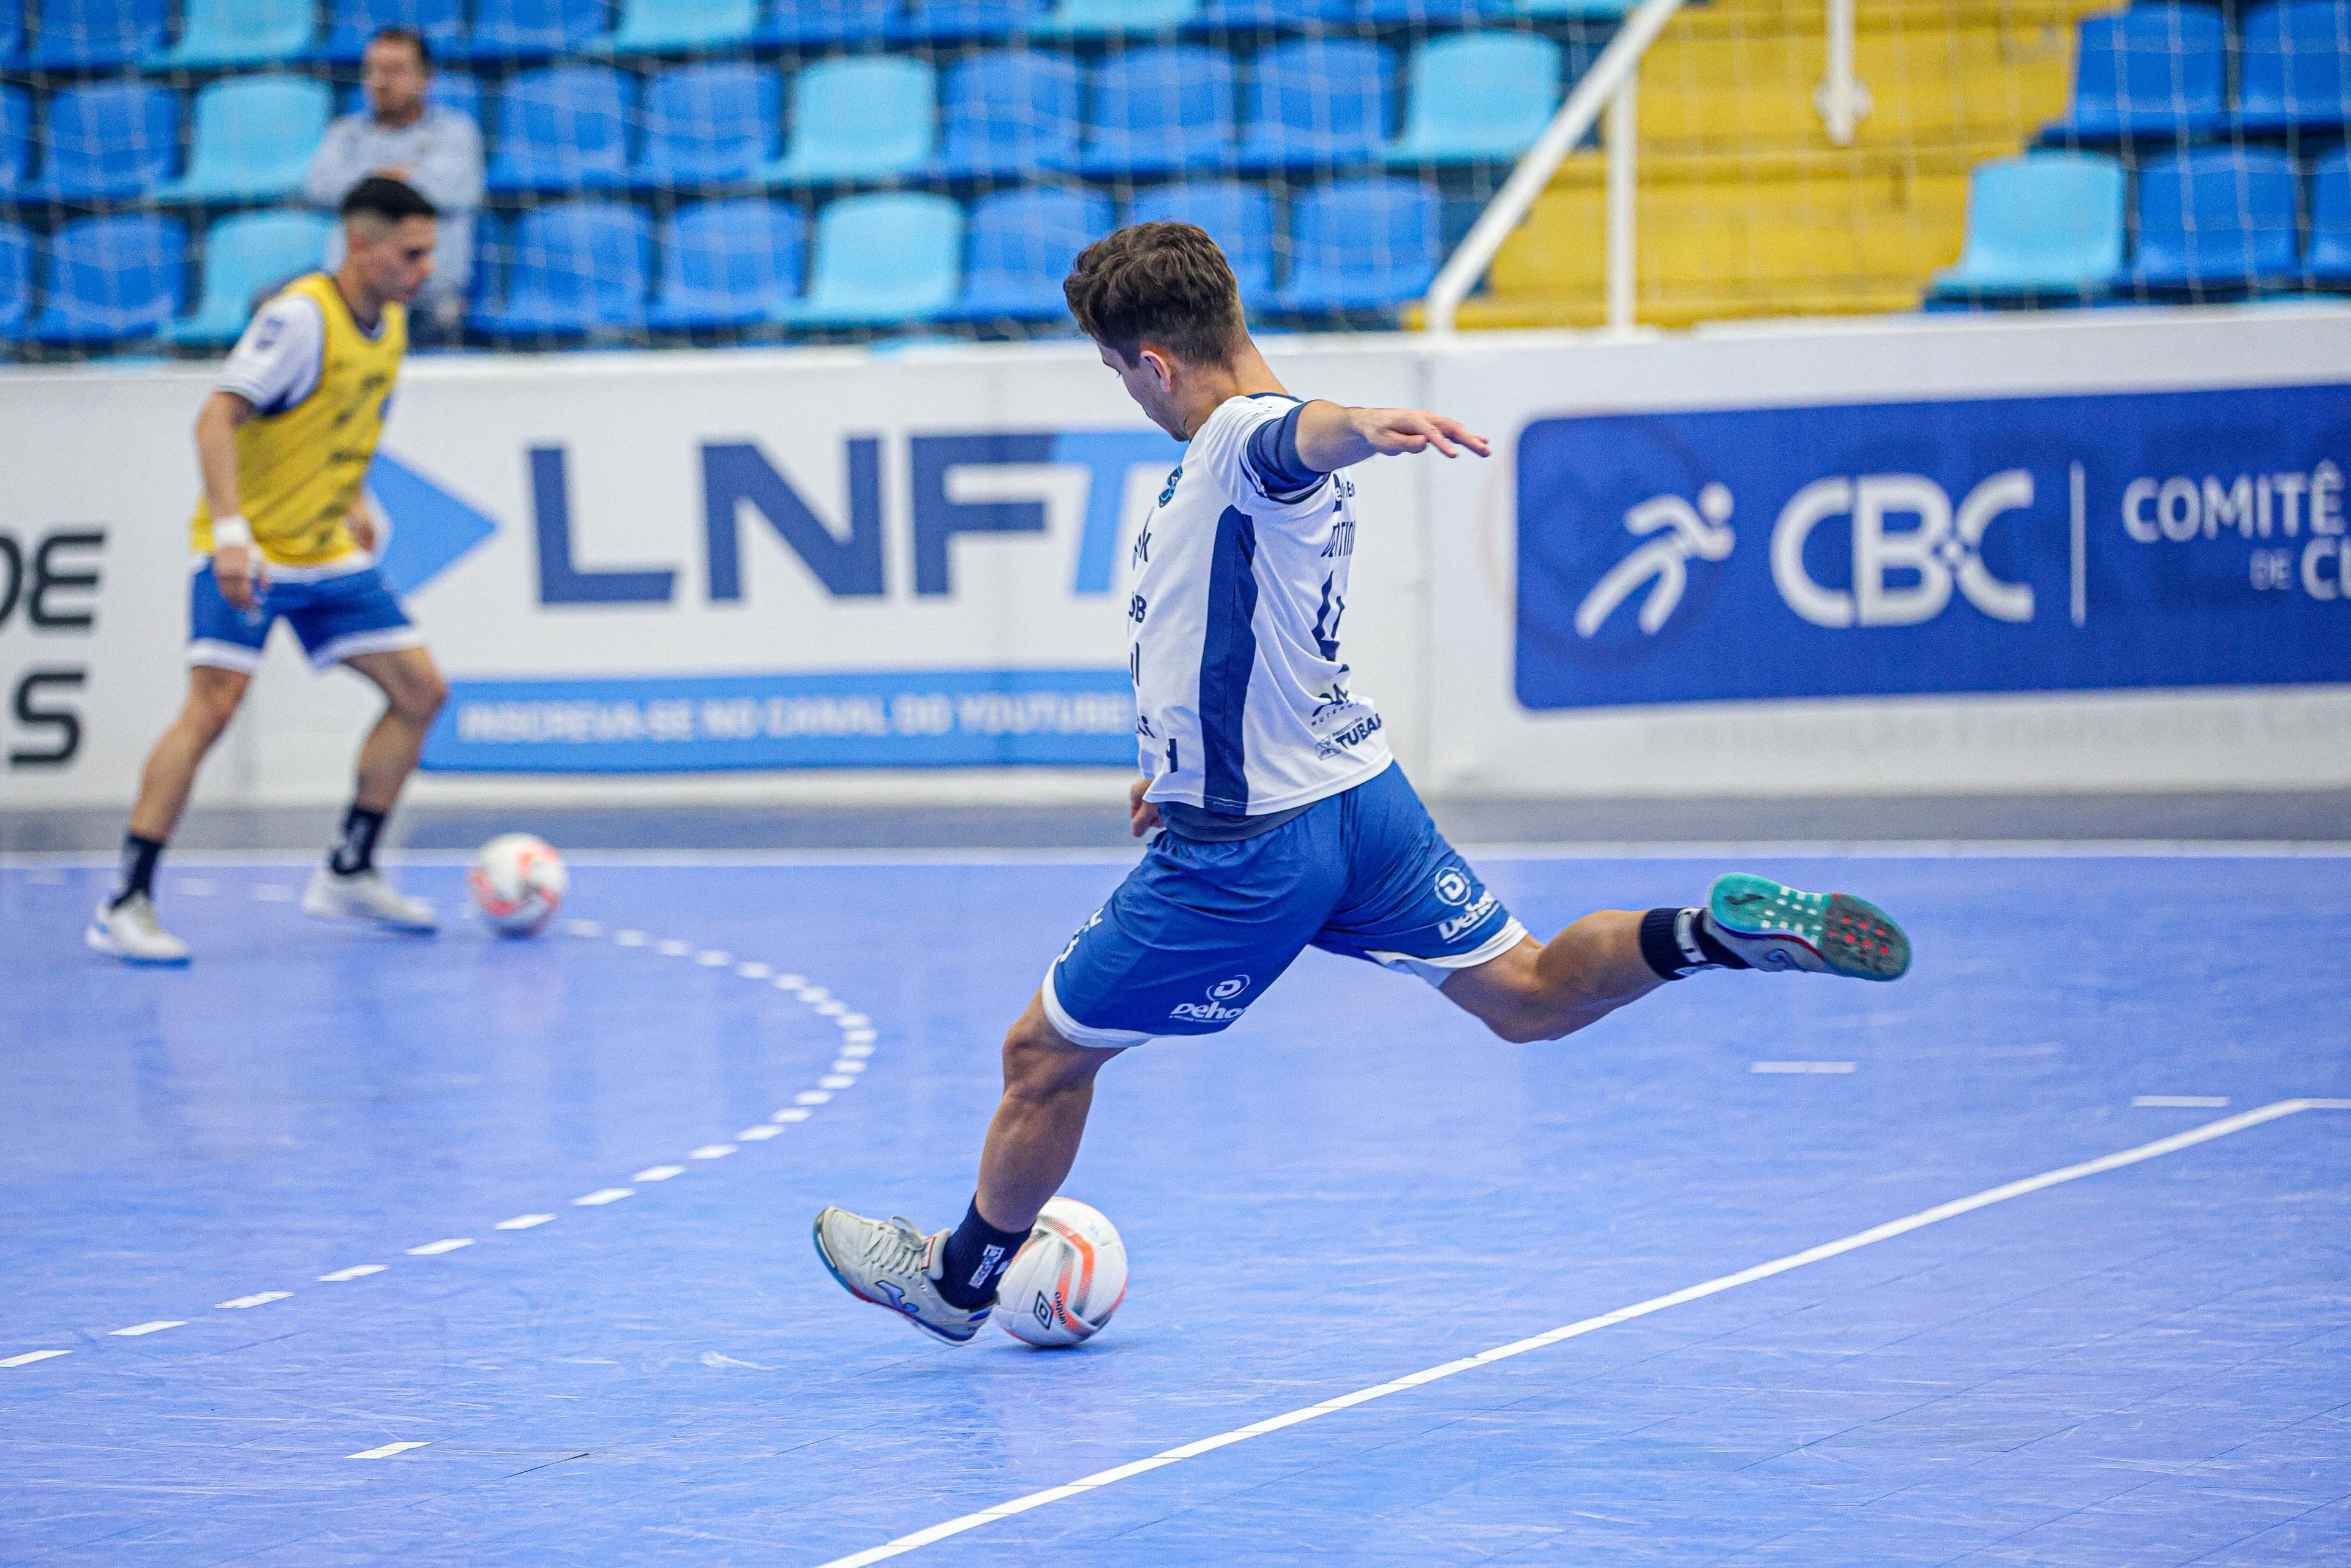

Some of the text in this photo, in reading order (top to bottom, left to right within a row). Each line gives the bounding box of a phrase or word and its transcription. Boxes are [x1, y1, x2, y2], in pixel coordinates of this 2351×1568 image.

[2122, 459, 2346, 543] COMITÊ
[1771, 469, 2034, 628] CBC
[2249, 549, 2292, 591] DE
